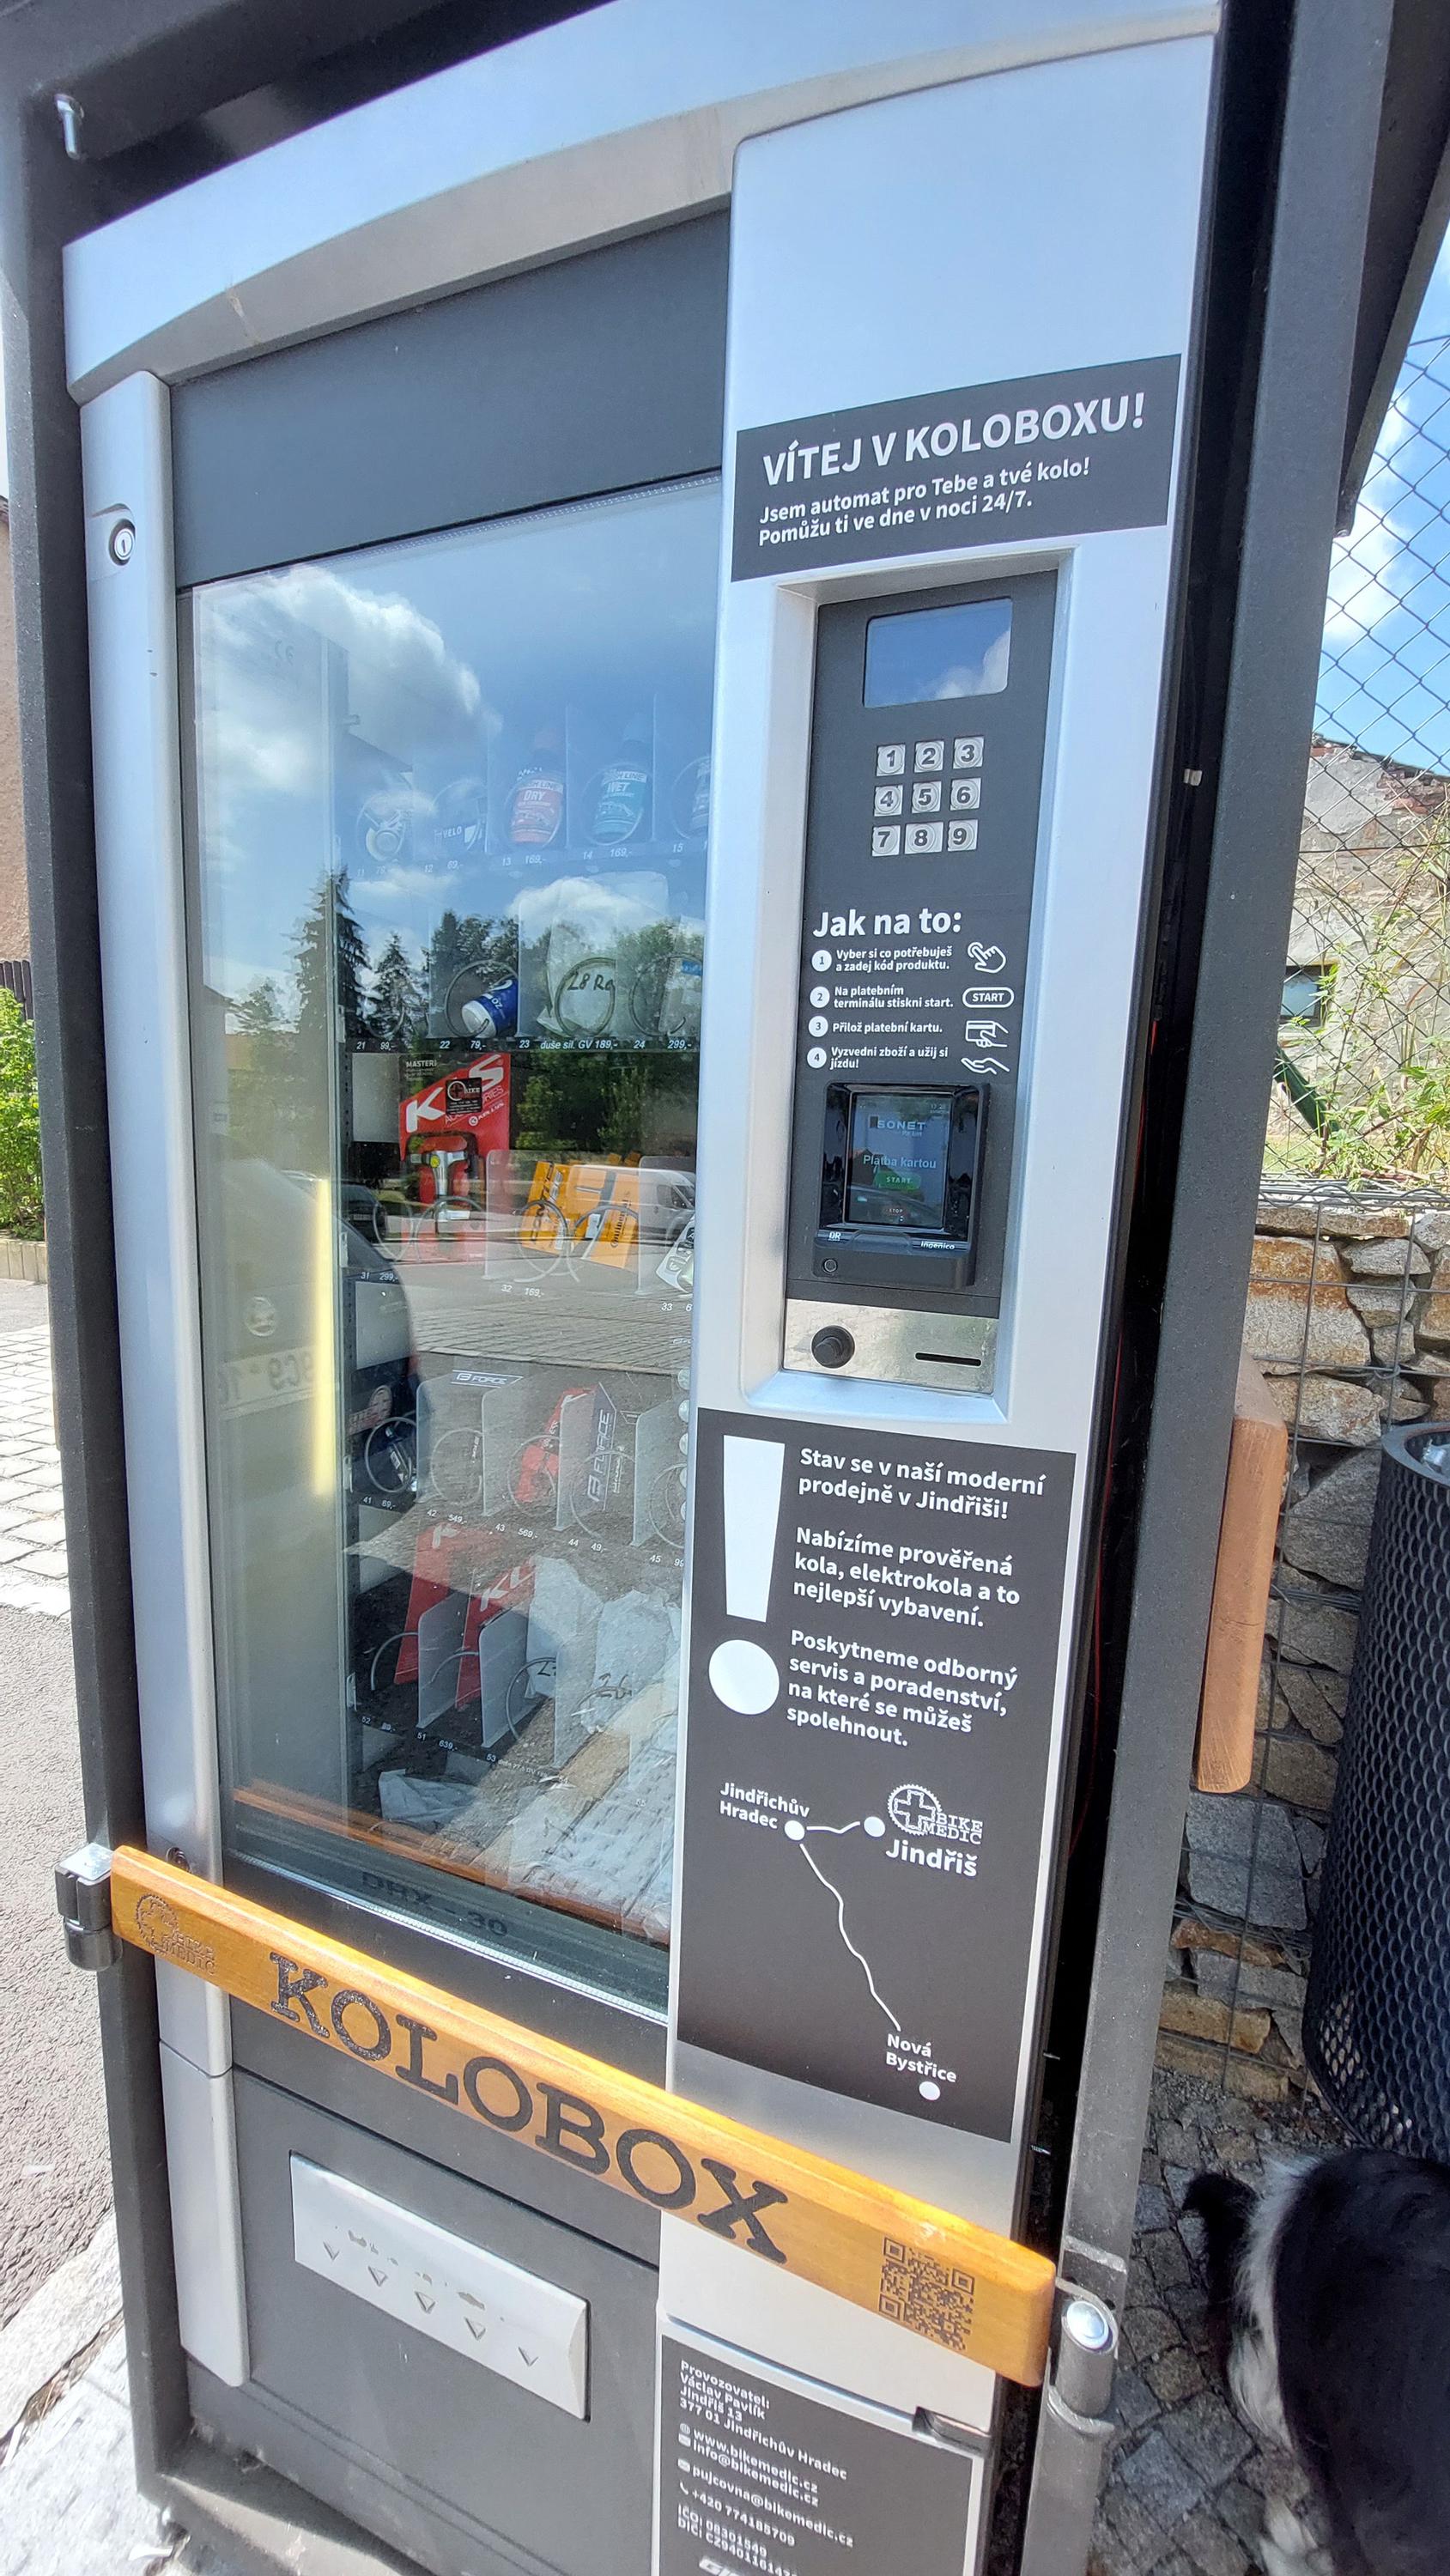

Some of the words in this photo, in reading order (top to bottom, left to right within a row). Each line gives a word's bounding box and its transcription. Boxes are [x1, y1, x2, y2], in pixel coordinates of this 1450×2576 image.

[762, 437, 861, 486] VÍTEJ
[872, 433, 897, 467] V
[905, 392, 1145, 461] KOLOBOXU!
[760, 503, 806, 525] Jsem
[810, 487, 889, 515] automat
[894, 483, 927, 504] pro
[931, 474, 978, 499] Tebe
[983, 473, 994, 489] a
[998, 461, 1034, 486] tvé
[1037, 457, 1091, 483] kolo!
[758, 518, 830, 547] Pomůžu
[834, 517, 848, 533] ti
[853, 515, 875, 532] ve
[879, 508, 915, 528] dne
[919, 507, 932, 523] v
[936, 498, 977, 519] noci
[981, 489, 1033, 513] 24/7.
[886, 750, 897, 767] 1
[922, 748, 936, 765] 2
[961, 744, 975, 762] 3
[524, 790, 545, 801] DRY
[880, 791, 894, 808] 4
[918, 788, 932, 805] 5
[956, 787, 971, 804] 6
[877, 830, 890, 848] 7
[913, 829, 928, 847] 8
[953, 827, 967, 845] 9
[610, 848, 632, 859] 169,-
[813, 909, 866, 937] Jak
[874, 914, 911, 935] na
[919, 908, 962, 934] to:
[836, 948, 867, 961] Vyber
[869, 948, 877, 958] si
[879, 949, 892, 959] co
[893, 945, 953, 960] potřebuješ
[835, 963, 842, 972] a
[844, 960, 871, 973] zadej
[874, 958, 894, 971] kód
[895, 958, 949, 973] produktu.
[834, 987, 848, 997] Na
[851, 983, 904, 998] platebním
[834, 995, 885, 1009] terminálu
[887, 997, 922, 1008] stiskni
[924, 997, 954, 1008] start.
[972, 993, 1004, 1003] START
[833, 1022, 863, 1033] Přilož
[864, 1021, 911, 1035] platební
[913, 1022, 943, 1033] kartu.
[356, 1041, 366, 1050] 21
[439, 1040, 451, 1049] 22
[470, 1040, 486, 1051] 79,-
[519, 1040, 530, 1049] 23
[540, 1039, 561, 1049] duše
[578, 1040, 594, 1049] GV
[595, 1040, 617, 1051] 189,-
[634, 1040, 645, 1049] 24
[667, 1040, 691, 1051] 299,-
[831, 1047, 877, 1060] Vyzvedni
[878, 1046, 907, 1058] zboží
[918, 1047, 937, 1060] užij
[939, 1048, 948, 1057] si
[830, 1057, 859, 1070] jízdu!
[877, 1120, 925, 1131] SONET
[863, 1155, 897, 1166] Platba
[901, 1157, 937, 1169] kartou
[661, 1303, 673, 1311] 33
[800, 1448, 845, 1470] Stav
[850, 1457, 873, 1474] se
[878, 1461, 892, 1476] v
[896, 1458, 943, 1483] naší
[947, 1469, 1047, 1496] moderní
[798, 1475, 893, 1504] prodejně
[898, 1492, 912, 1506] v
[915, 1491, 1009, 1519] Jindřiši!
[495, 1523, 506, 1532] 43
[518, 1528, 538, 1540] 569,-
[568, 1538, 579, 1546] 44
[650, 1554, 661, 1564] 45
[796, 1527, 894, 1558] Nabízíme
[899, 1544, 1013, 1577] prověřená
[795, 1552, 845, 1580] kola,
[849, 1563, 972, 1599] elektrokola
[978, 1587, 991, 1601] a
[996, 1585, 1020, 1605] to
[793, 1579, 876, 1610] nejlepší
[878, 1594, 984, 1628] vybavení.
[791, 1629, 919, 1669] Poskytneme
[924, 1656, 1018, 1691] odborný
[789, 1656, 848, 1683] servis
[853, 1670, 865, 1685] a
[870, 1673, 1007, 1716] poradenství,
[788, 1683, 812, 1700] na
[817, 1686, 871, 1713] které
[875, 1700, 897, 1717] se
[902, 1704, 973, 1734] můžeš
[786, 1704, 908, 1747] spolehnout.
[417, 1732, 426, 1741] 51
[439, 1739, 458, 1752] 639,-
[486, 1753, 496, 1762] 53
[720, 1783, 810, 1818] Jindřichův
[719, 1801, 778, 1830] Hradec
[936, 1812, 983, 1833] BIKE
[923, 1821, 982, 1844] MEDIC
[886, 1839, 978, 1876] Jindřiš
[468, 1911, 508, 1936] 30
[888, 2033, 931, 2057] Nová
[886, 2052, 957, 2082] Bystřice
[269, 1952, 788, 2265] KOLOBOX
[680, 2372, 722, 2399] Václav
[725, 2392, 766, 2420] Pavlík
[681, 2360, 770, 2409] Provozovatel:
[680, 2386, 725, 2414] Jindřiš
[727, 2407, 743, 2422] 13
[680, 2397, 701, 2415] 377
[705, 2409, 720, 2425] 01
[724, 2419, 795, 2458] Jindřichův
[798, 2450, 847, 2480] Hradec
[693, 2429, 818, 2494] www.bikemedic.cz
[693, 2439, 819, 2507] info@bikemedic.cz
[692, 2489, 722, 2512] +420
[693, 2464, 854, 2549] pujcovna@bikemedic.cz
